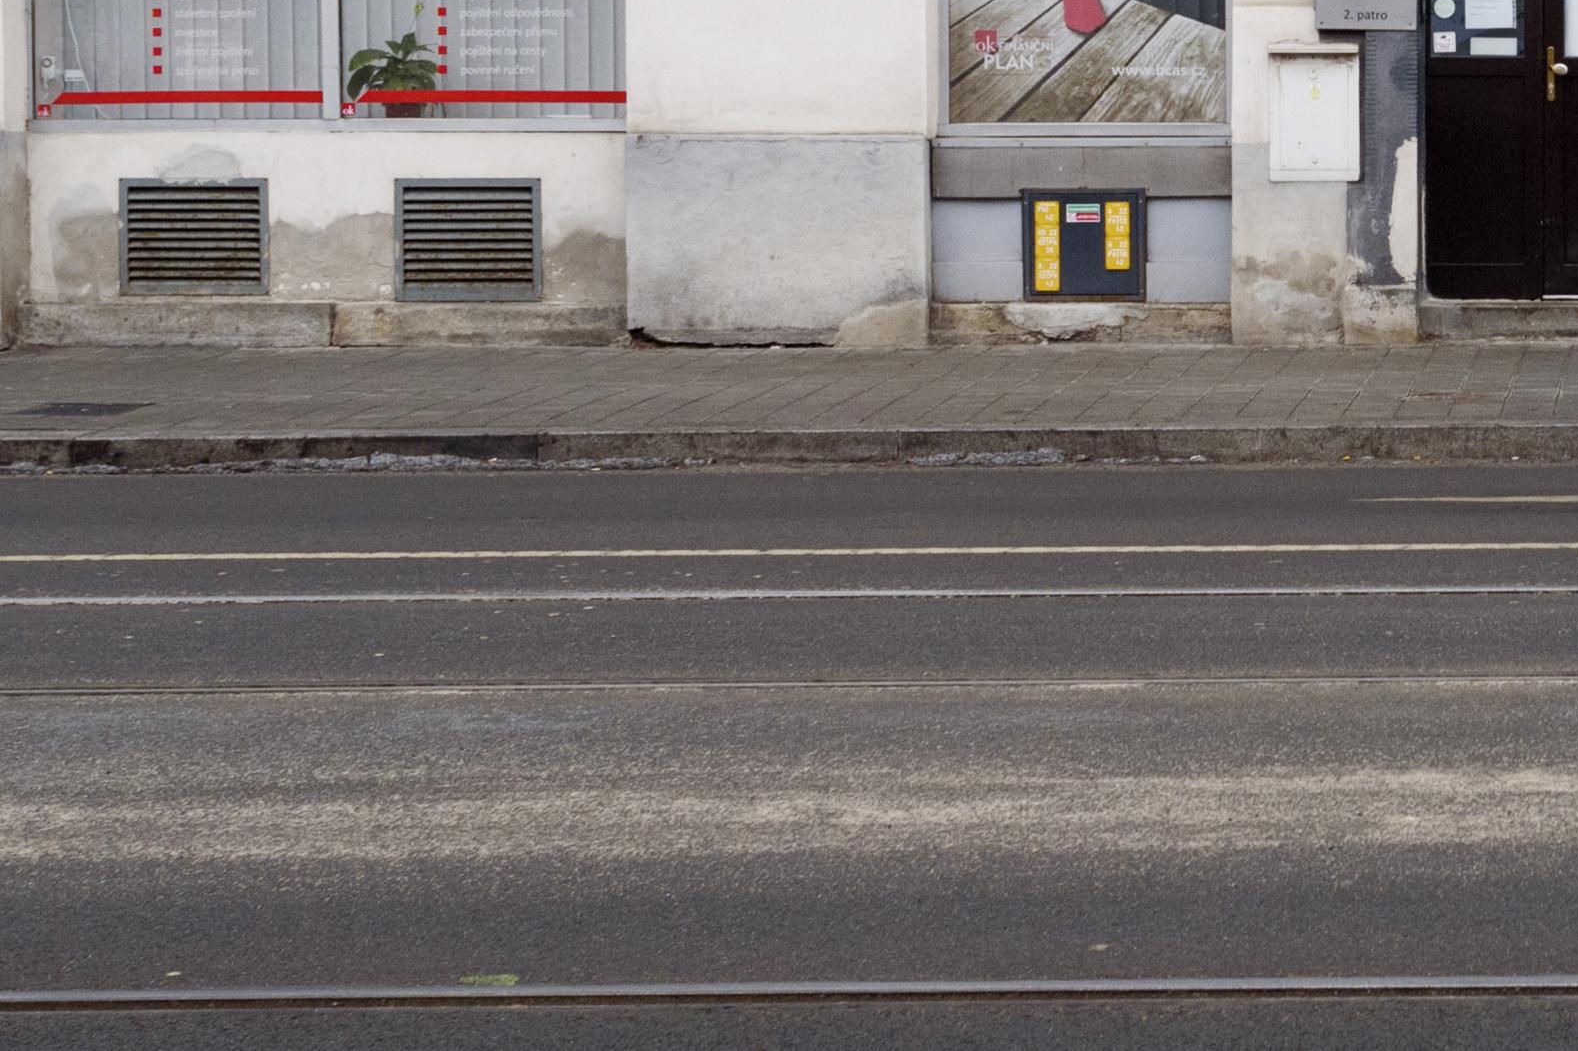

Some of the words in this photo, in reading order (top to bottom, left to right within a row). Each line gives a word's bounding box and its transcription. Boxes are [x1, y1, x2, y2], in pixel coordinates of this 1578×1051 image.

[1343, 9, 1354, 21] 2.
[1357, 10, 1388, 22] patro
[976, 35, 996, 53] ok
